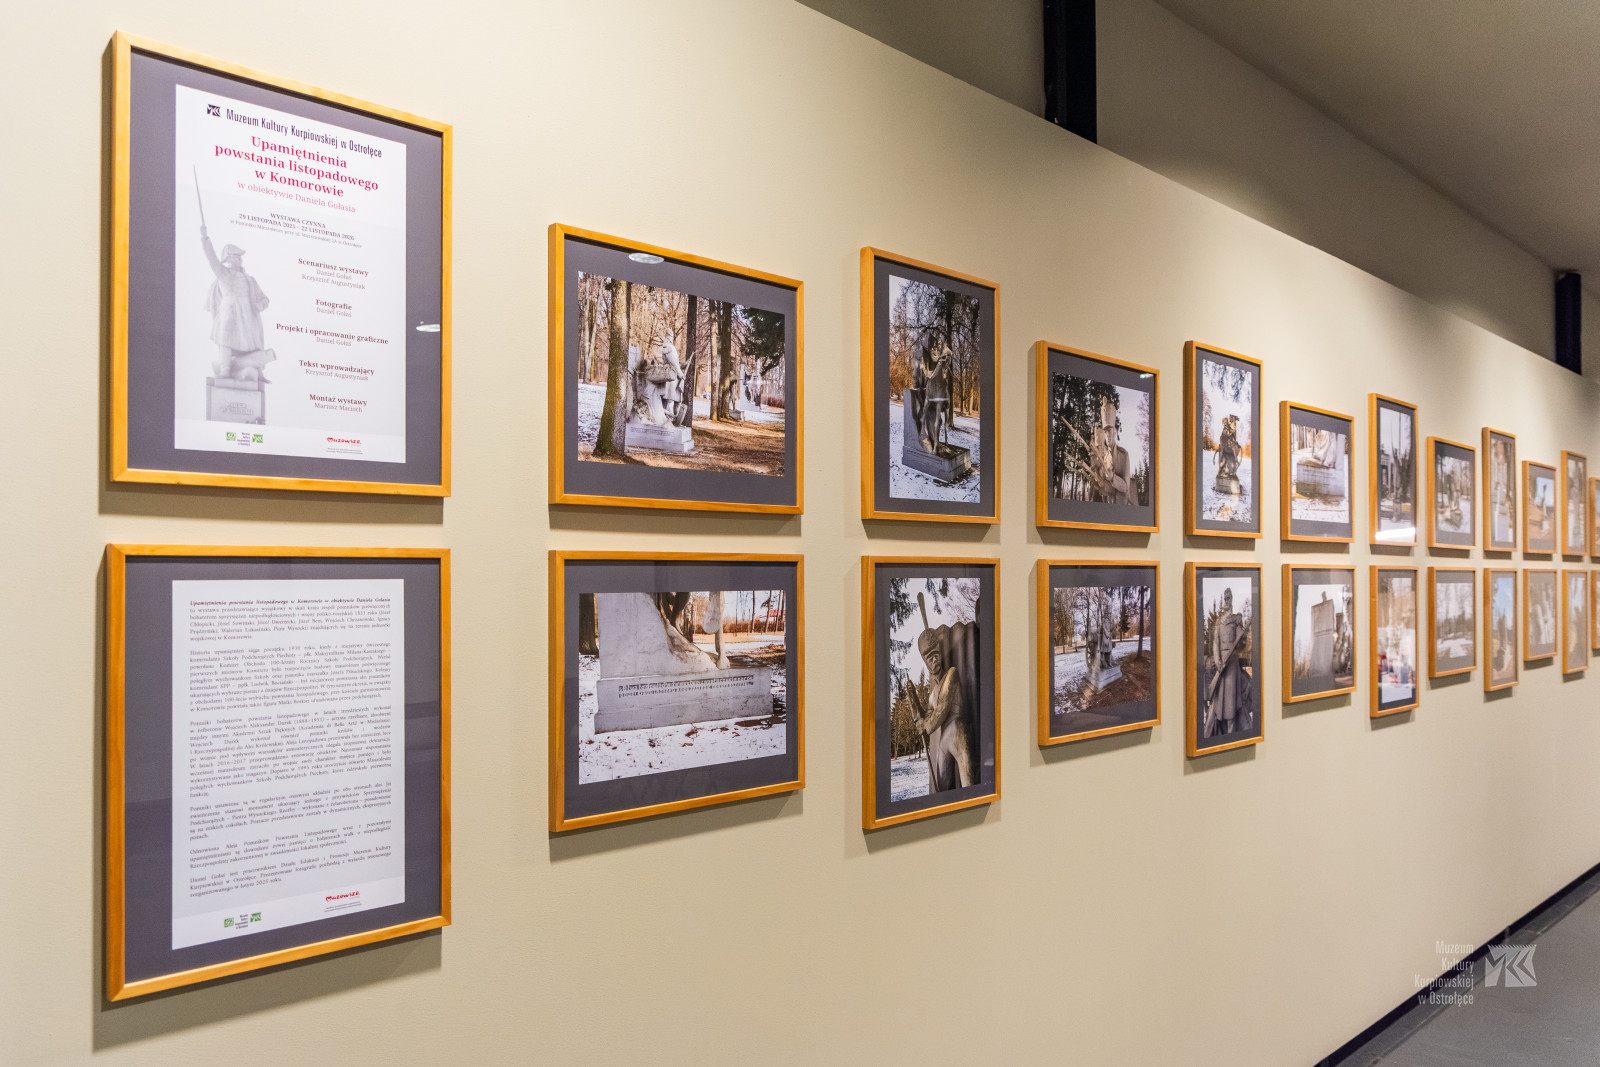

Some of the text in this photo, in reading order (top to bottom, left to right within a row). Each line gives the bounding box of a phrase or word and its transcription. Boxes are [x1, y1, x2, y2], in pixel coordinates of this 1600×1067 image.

[226, 108, 381, 158] Muzeum Kultury Kurpiowskiej w Ostrołęce
[251, 135, 346, 168] Upamiętnienia
[215, 145, 378, 191] powstania listopadowego
[254, 169, 343, 197] w Komorowie
[237, 181, 355, 212] w obiektywie Daniela Gołasia
[270, 212, 325, 228] WYSTAWA CZYNNA
[297, 257, 368, 277] Scenariusz wystawy
[315, 298, 352, 310] Fotografie
[276, 322, 303, 332] Projekt
[309, 329, 355, 340] opracowanie
[356, 335, 388, 344] graficzne
[298, 359, 374, 376] Tekst wprowadzający
[309, 393, 367, 406] Montaż wystawy
